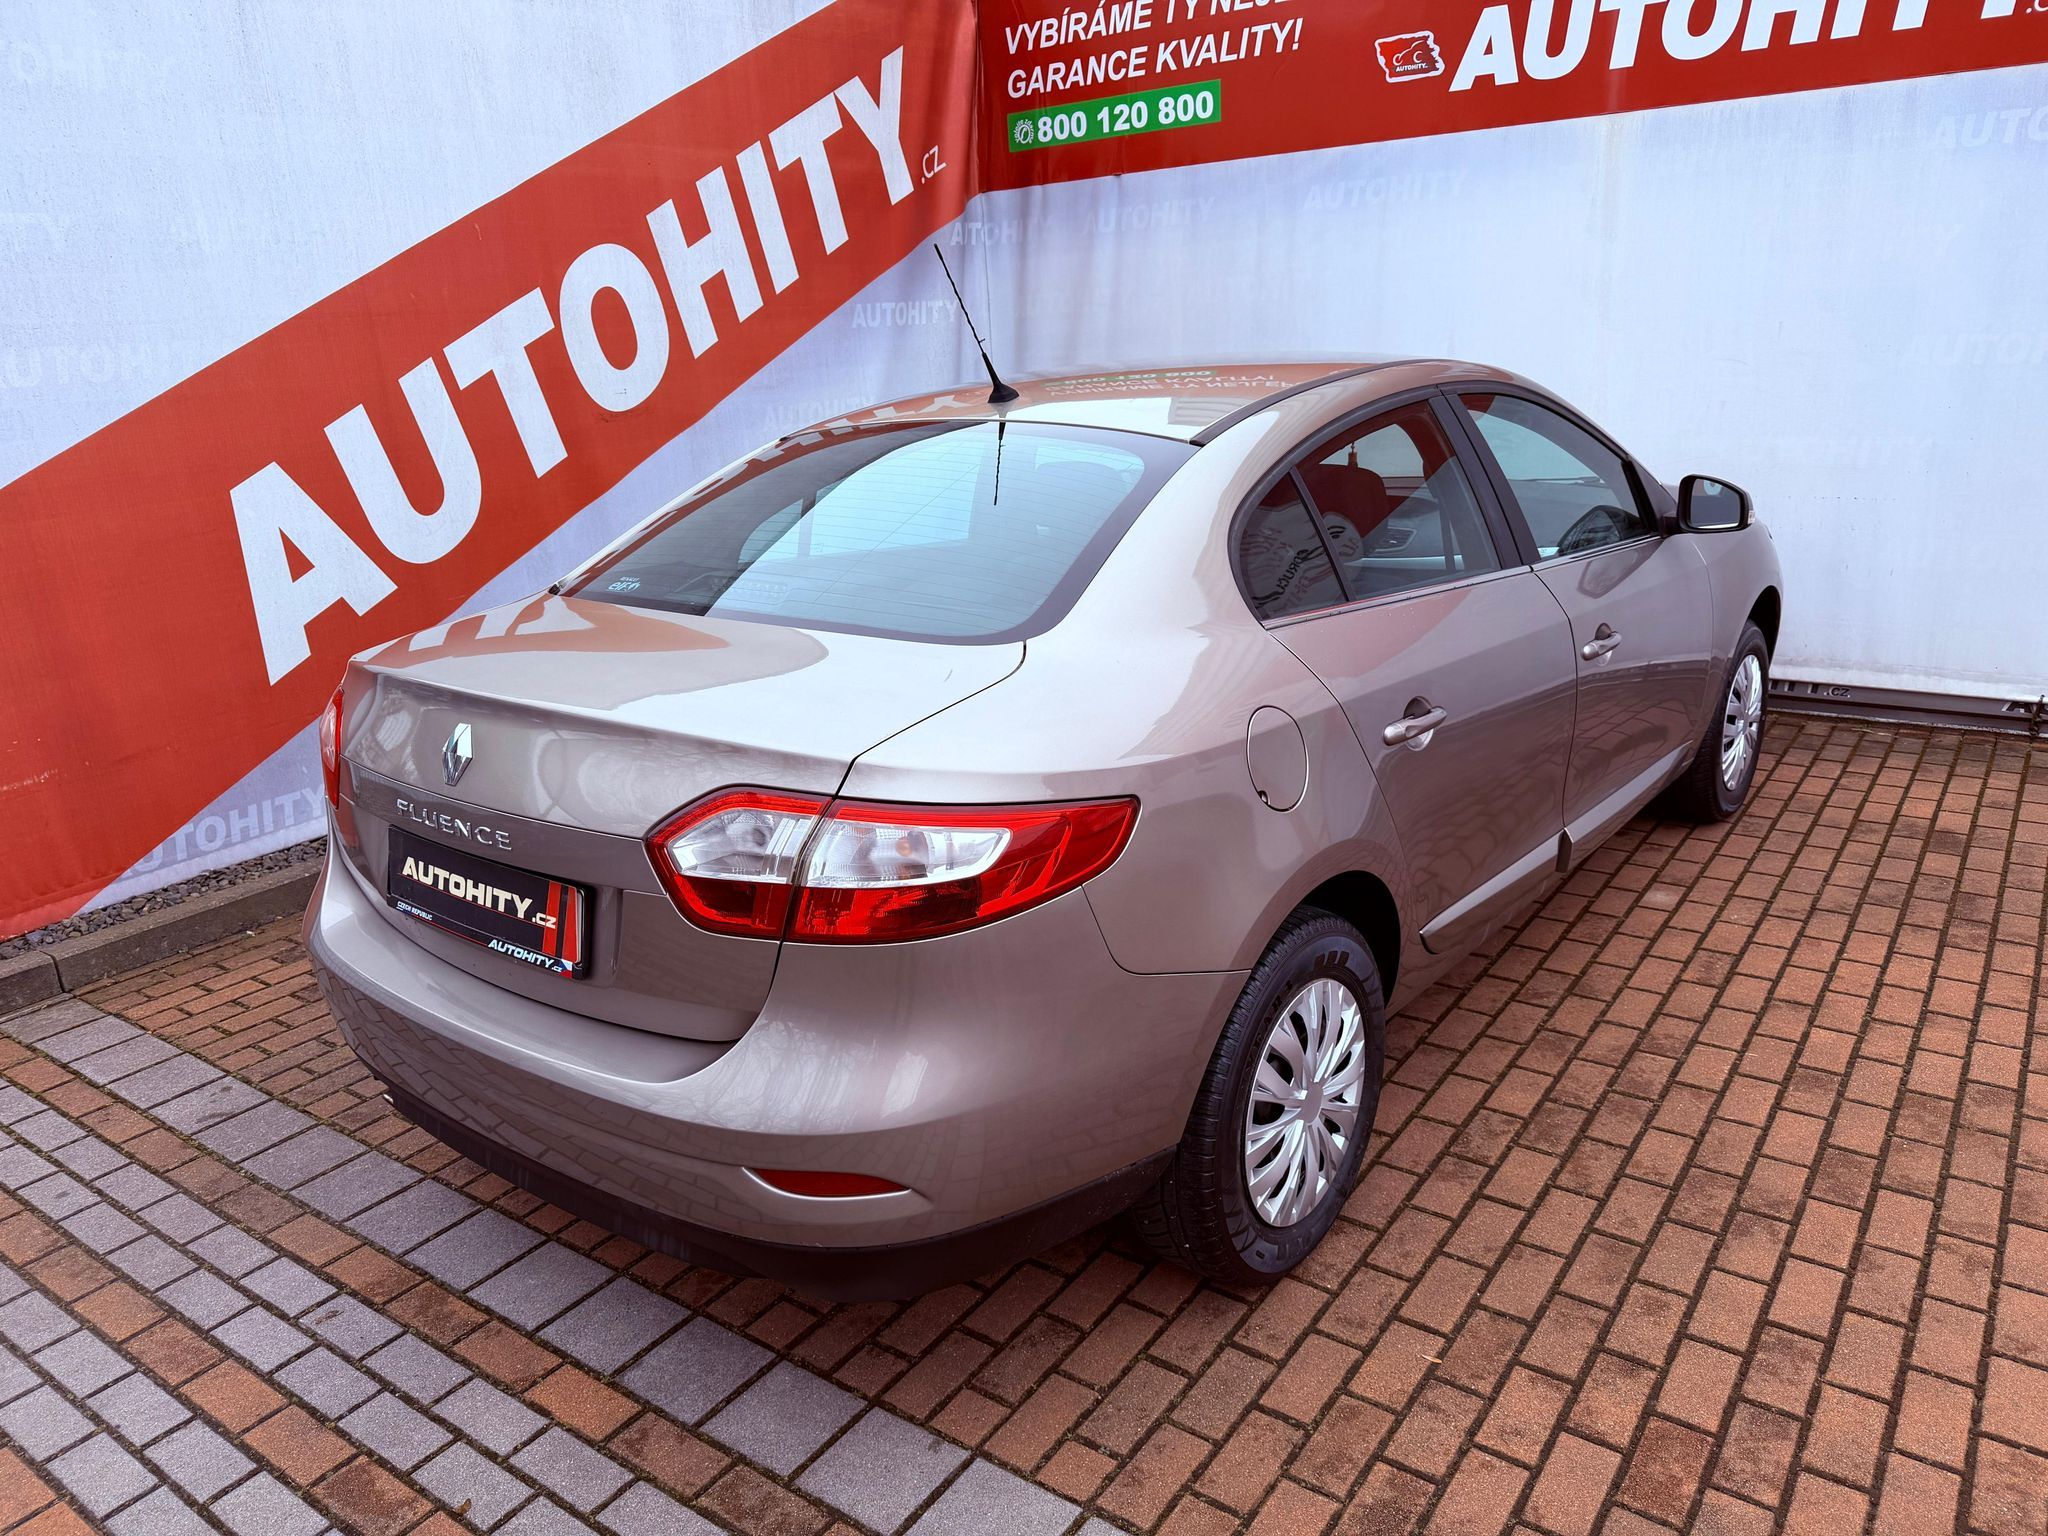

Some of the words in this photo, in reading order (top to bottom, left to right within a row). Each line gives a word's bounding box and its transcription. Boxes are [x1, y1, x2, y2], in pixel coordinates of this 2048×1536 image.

[1005, 0, 1151, 55] VYBÍRÁME
[1008, 46, 1148, 99] GARANCE
[1157, 17, 1304, 74] KVALITY!
[1037, 110, 1087, 143] 800
[1097, 100, 1148, 134] 120
[1158, 90, 1215, 125] 800
[852, 299, 960, 329] AUTOHITY
[396, 798, 513, 850] FLUENCE
